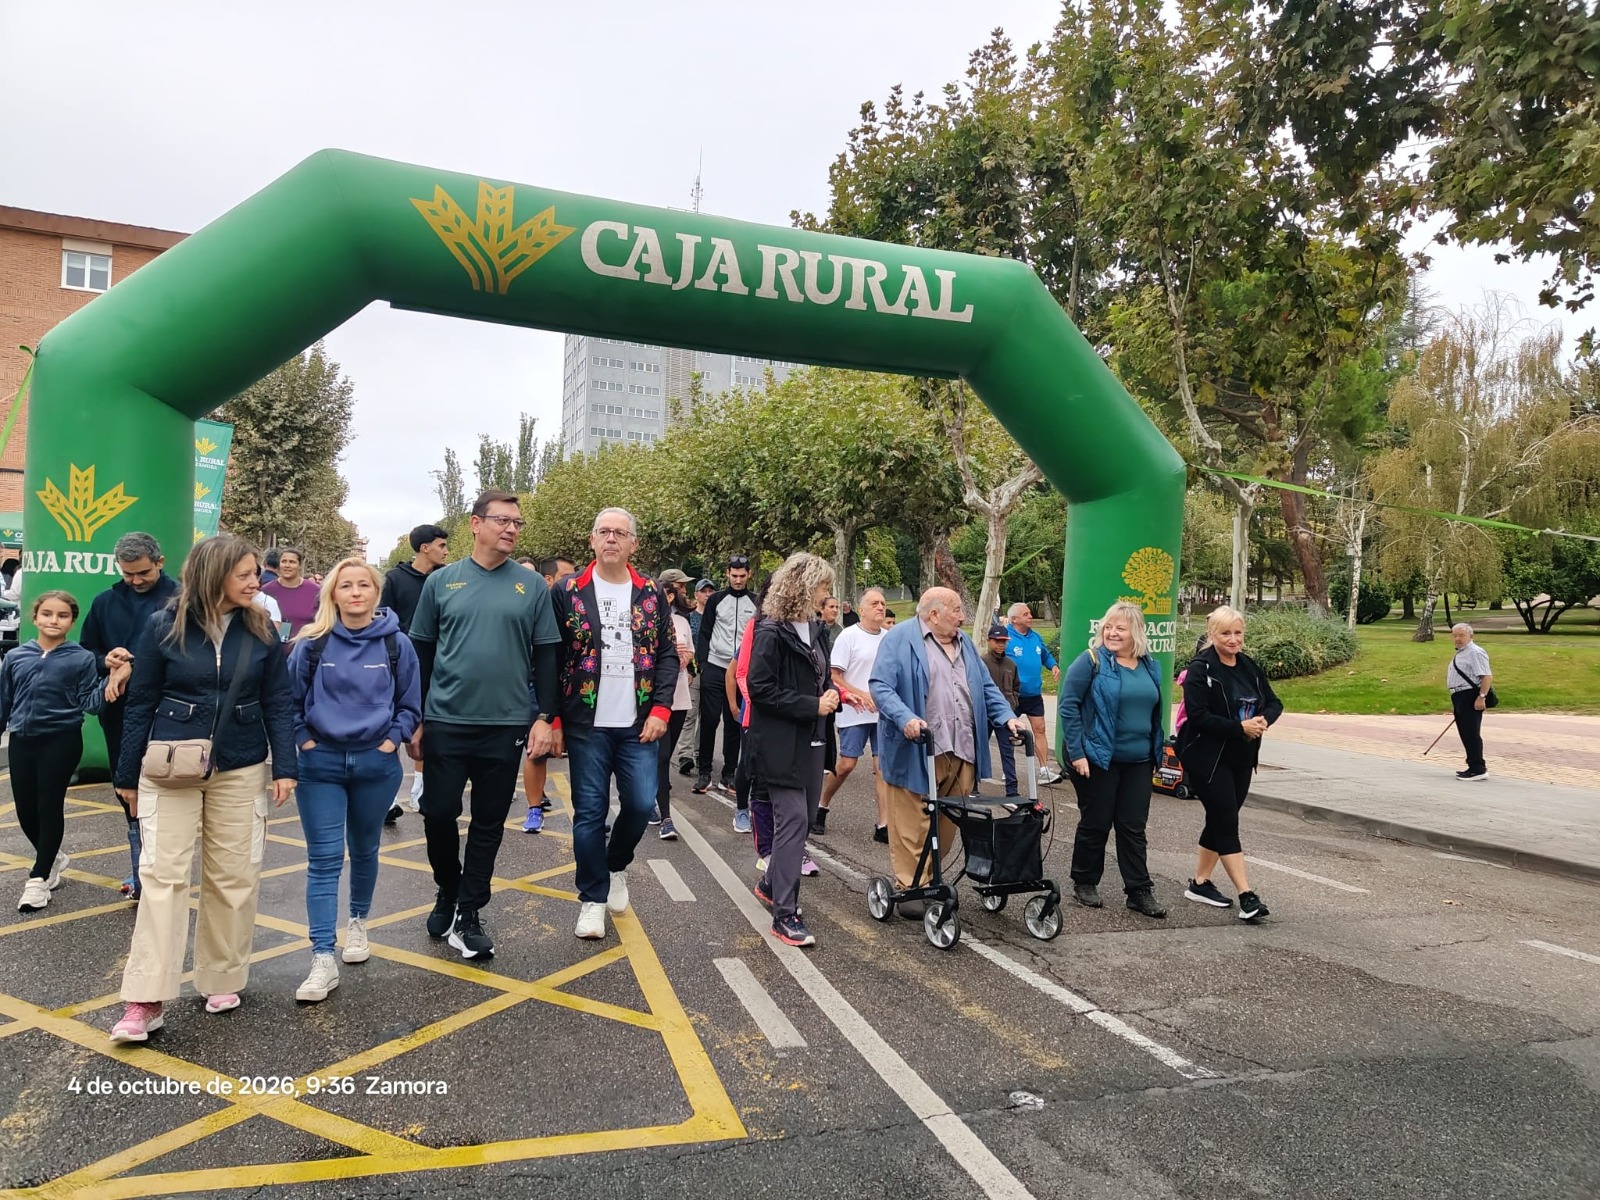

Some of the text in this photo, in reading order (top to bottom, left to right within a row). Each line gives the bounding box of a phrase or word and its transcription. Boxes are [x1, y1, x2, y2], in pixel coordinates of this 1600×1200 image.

[580, 220, 975, 323] CAJA RURAL
[200, 456, 226, 466] RURAL
[22, 550, 124, 576] CAJA RUR
[1146, 638, 1176, 653] RURA
